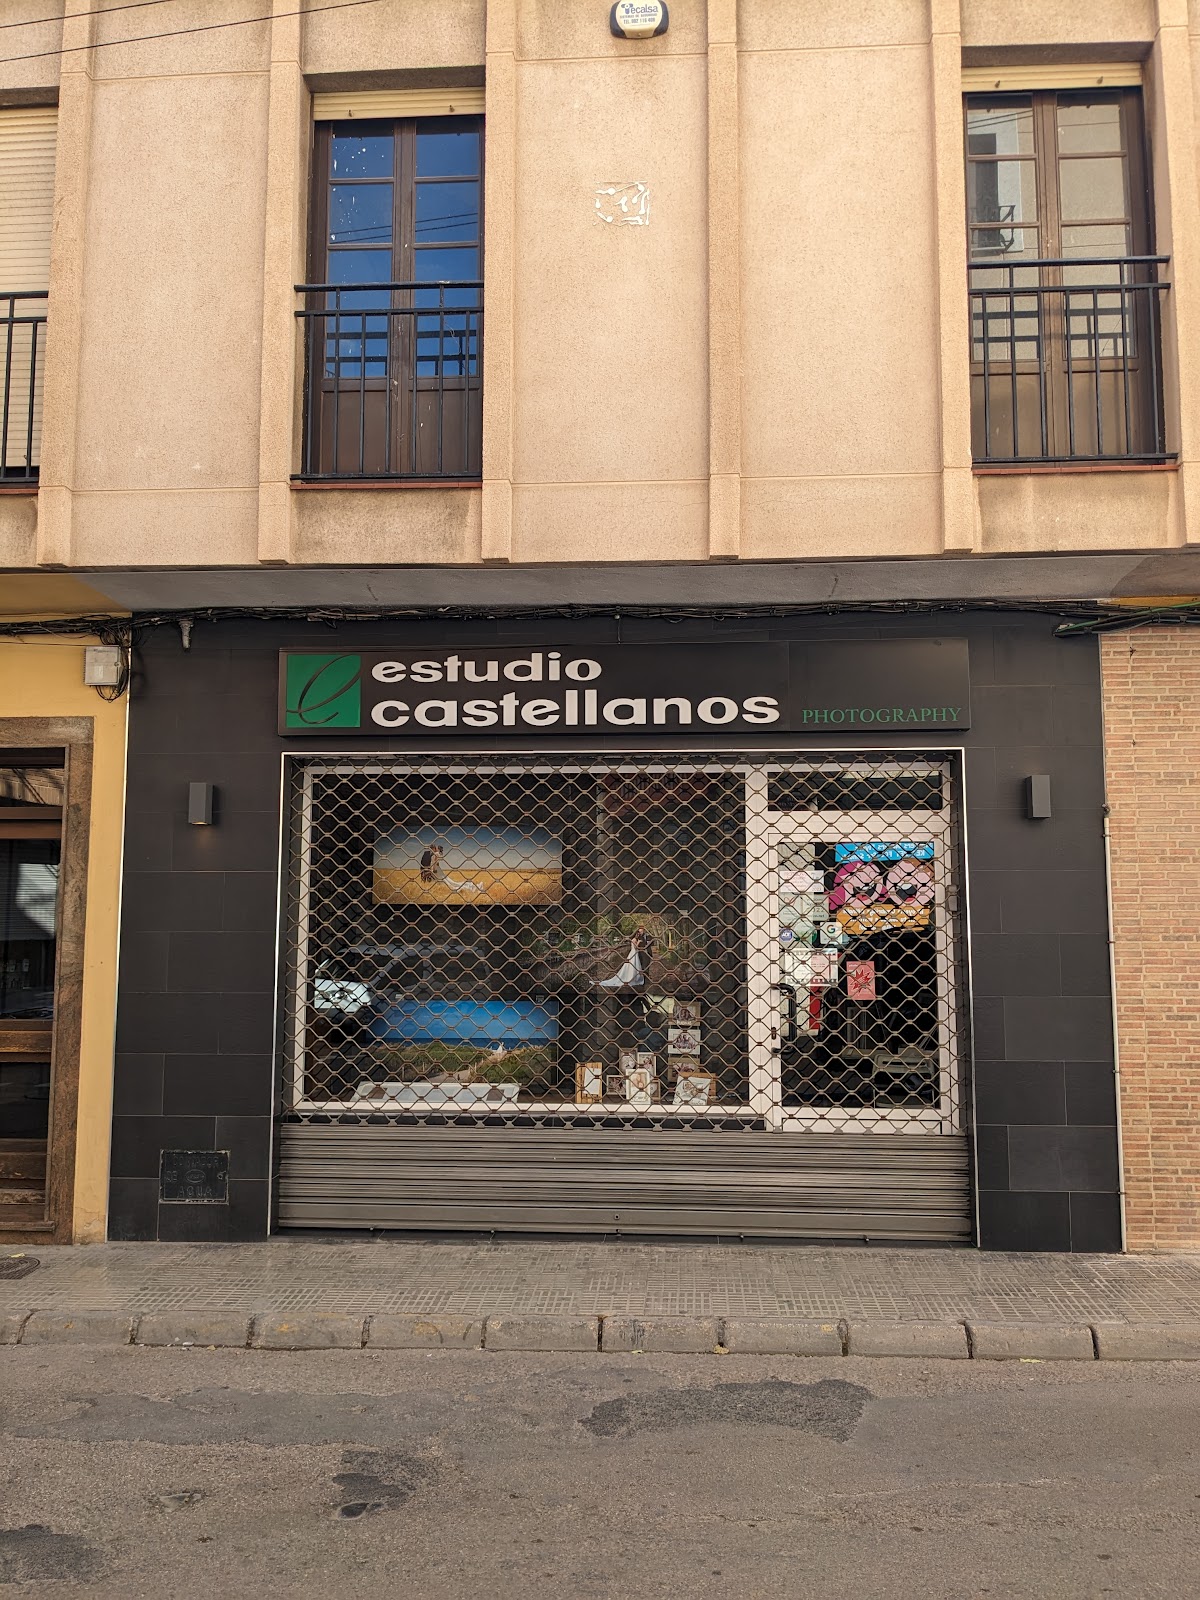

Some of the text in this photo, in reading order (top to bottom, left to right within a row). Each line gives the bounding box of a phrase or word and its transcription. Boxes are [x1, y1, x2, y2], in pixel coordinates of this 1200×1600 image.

[371, 652, 602, 682] estudio
[370, 689, 780, 727] castellanos
[802, 707, 957, 724] PHOTOGRAPHY
[826, 924, 836, 934] G
